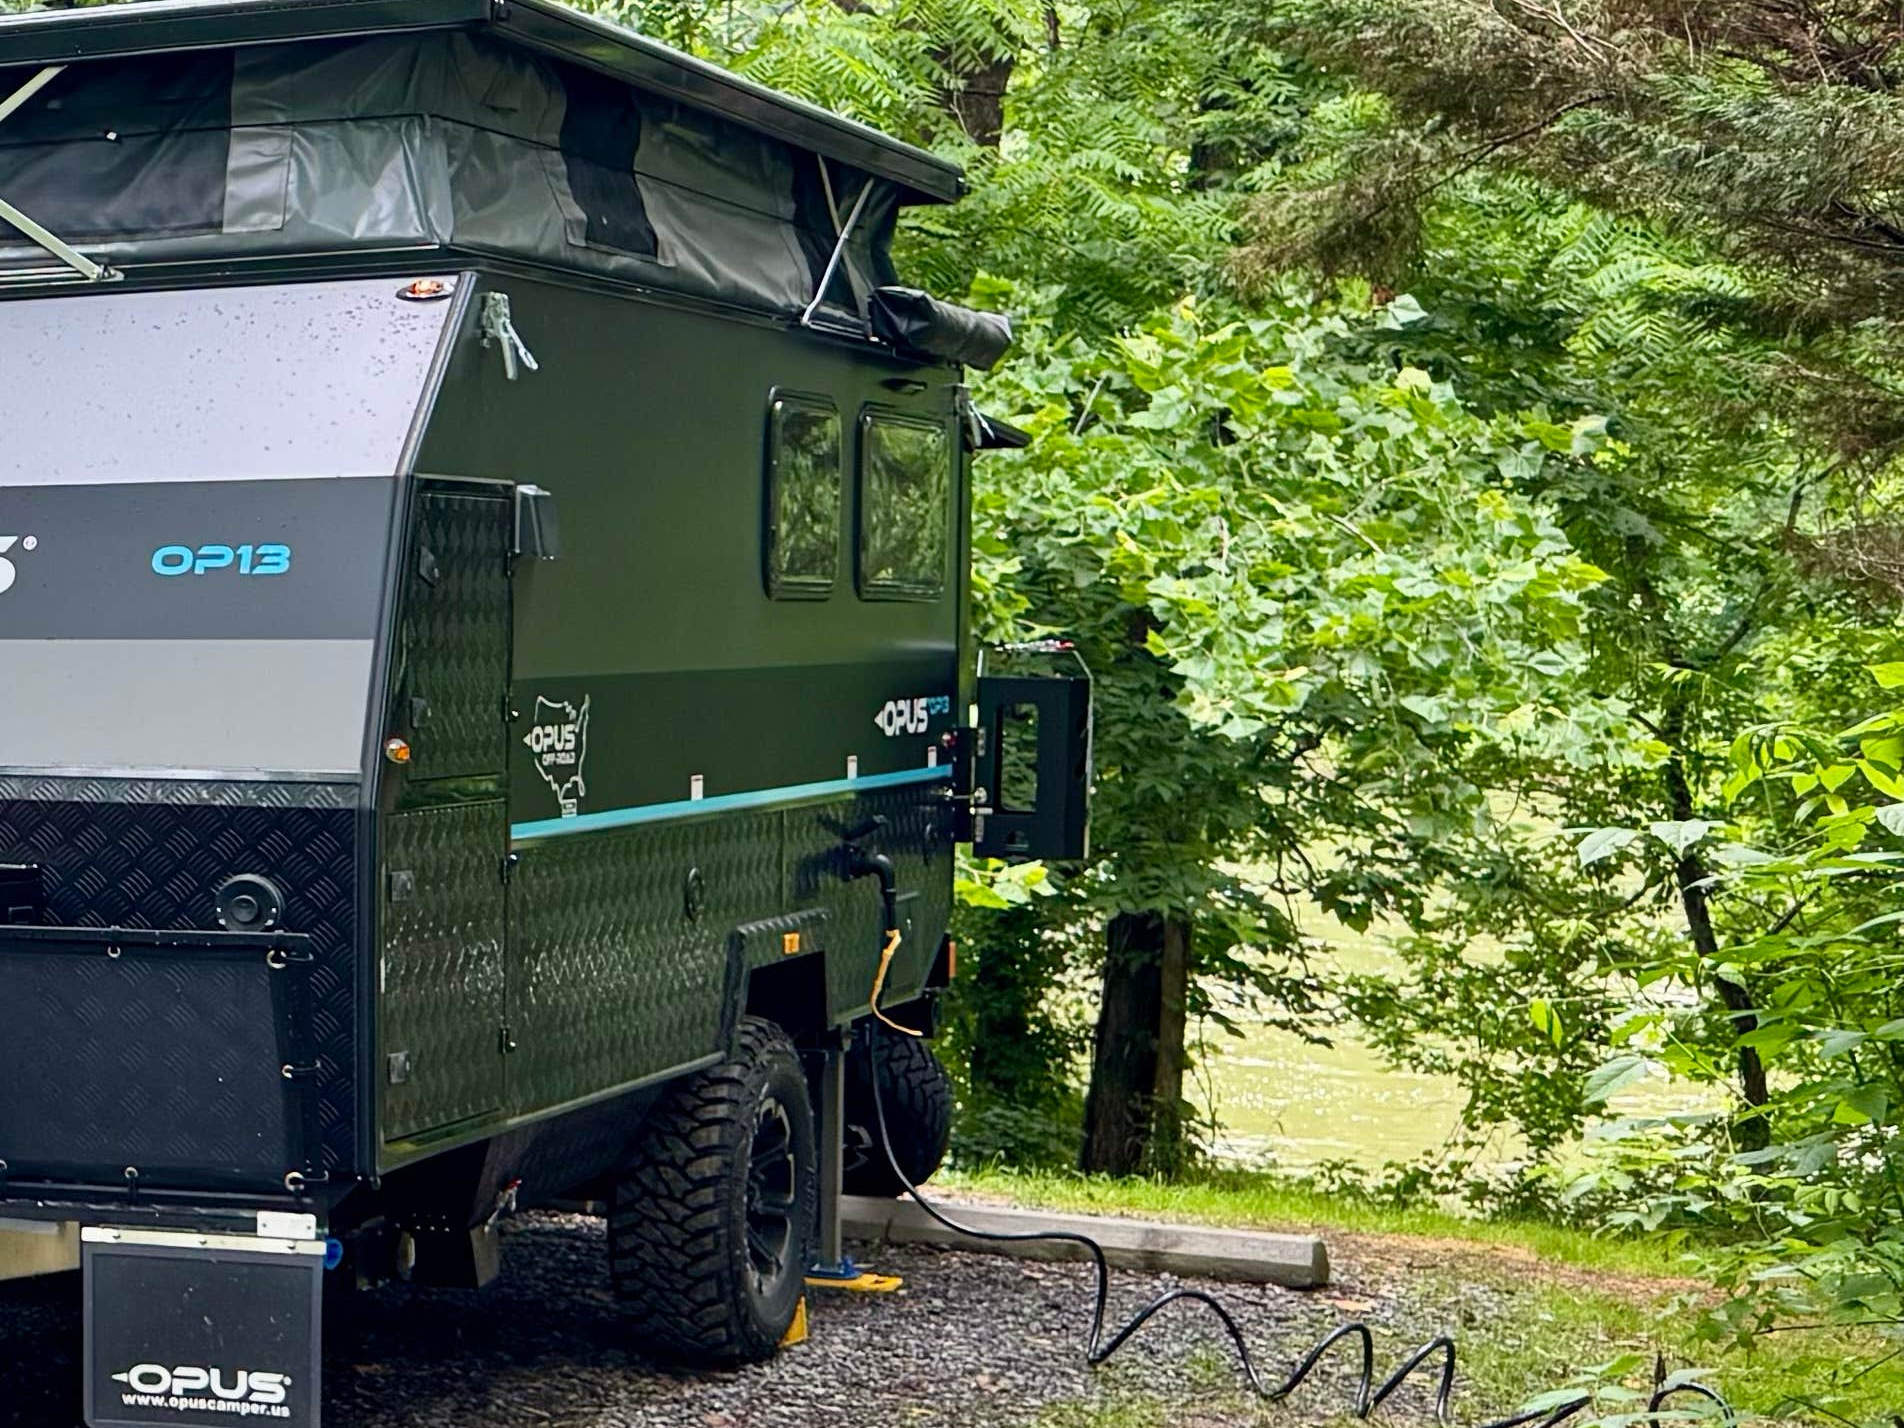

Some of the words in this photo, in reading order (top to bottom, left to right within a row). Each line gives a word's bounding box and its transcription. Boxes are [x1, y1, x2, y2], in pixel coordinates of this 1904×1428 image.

[151, 544, 292, 576] OP13
[883, 697, 928, 737] OPUS
[532, 724, 576, 753] OPUS
[128, 1363, 288, 1404] OPUS
[121, 1393, 291, 1418] www.opuscamper.us
